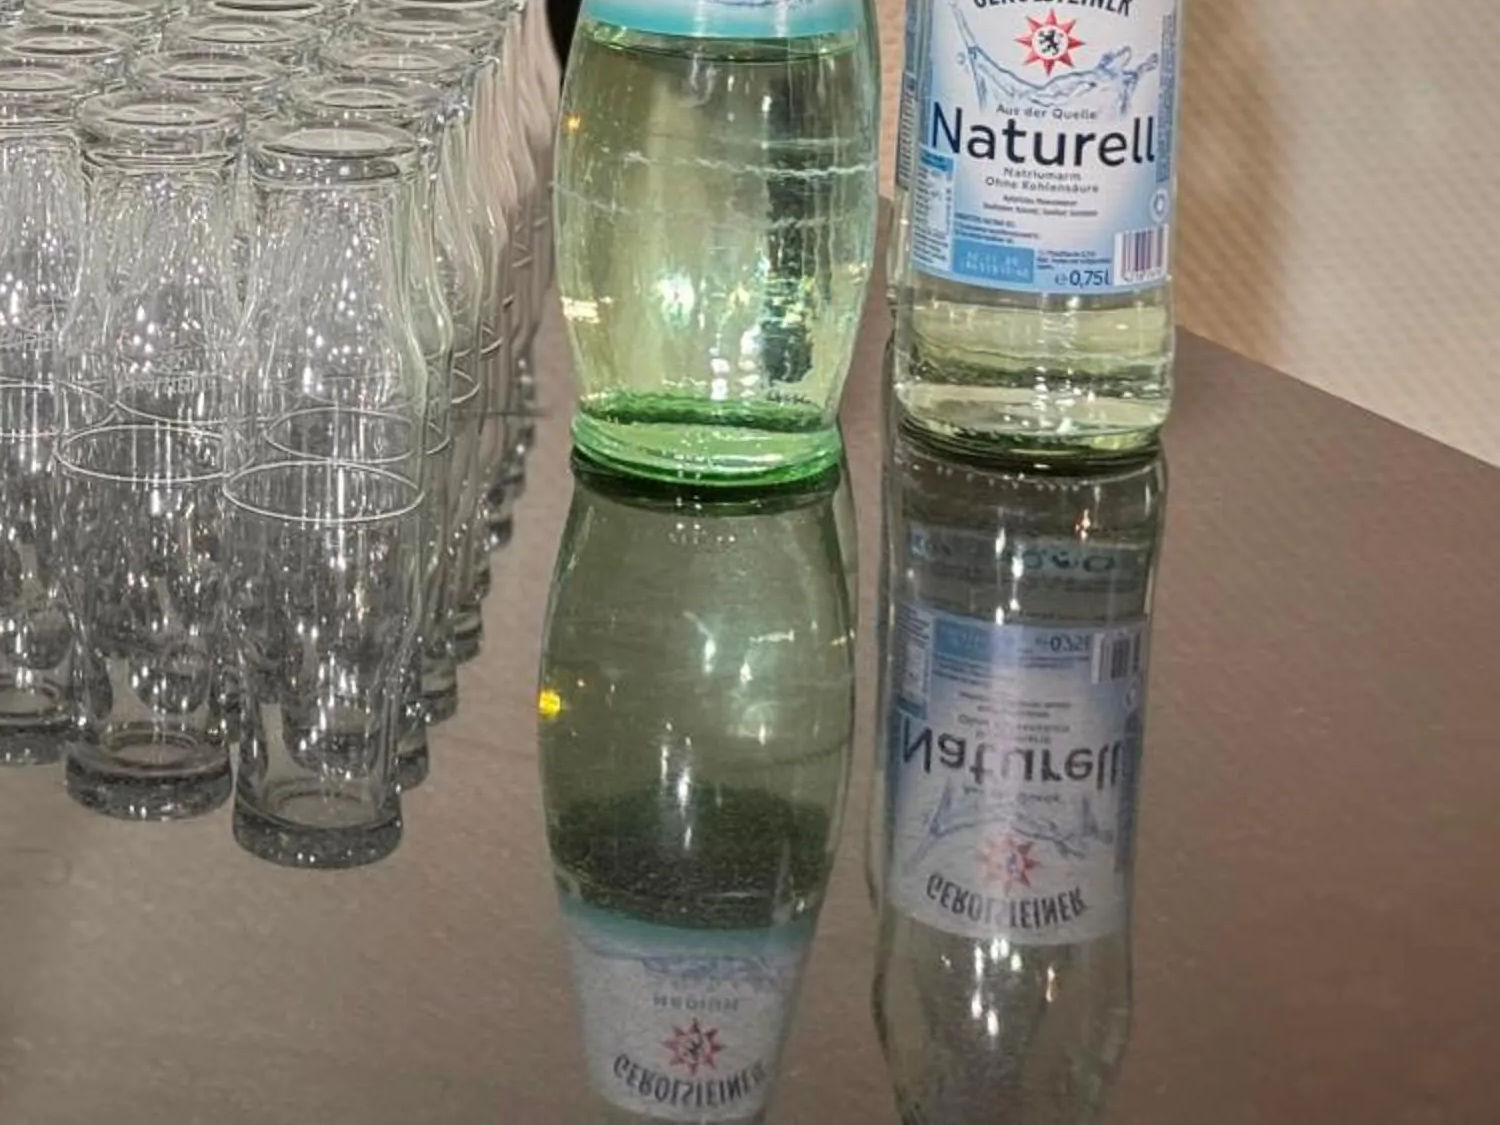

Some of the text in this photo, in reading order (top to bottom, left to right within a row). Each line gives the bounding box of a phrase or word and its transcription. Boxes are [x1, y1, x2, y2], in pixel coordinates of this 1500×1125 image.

[996, 104, 1098, 121] Aus der Quelle
[931, 102, 1156, 167] Naturell
[985, 176, 1017, 189] Ohne
